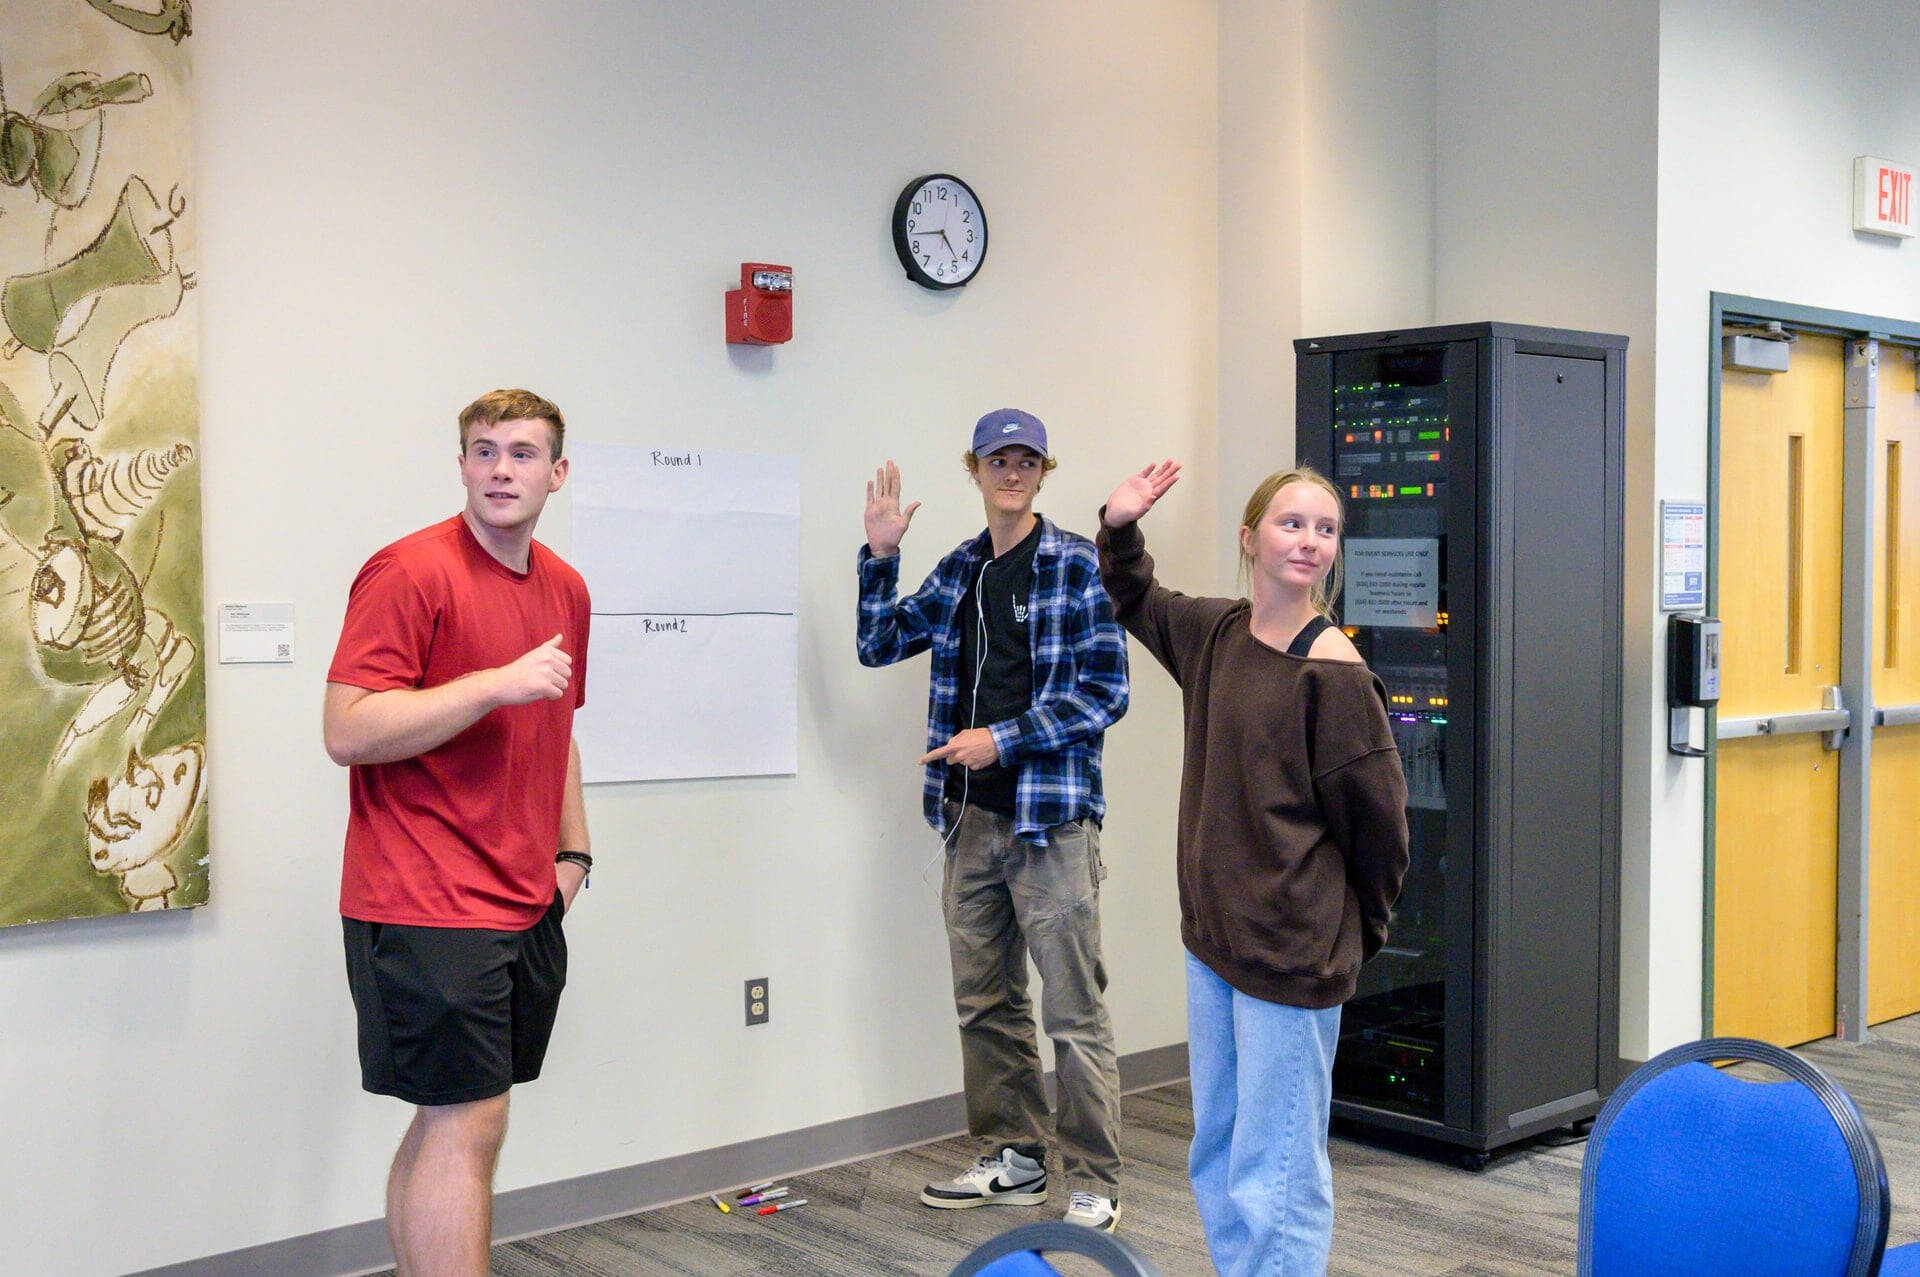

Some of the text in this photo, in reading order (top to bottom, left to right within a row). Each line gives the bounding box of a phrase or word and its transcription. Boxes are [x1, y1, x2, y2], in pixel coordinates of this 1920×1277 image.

[923, 189, 932, 204] 11
[936, 186, 947, 200] 12
[1878, 168, 1911, 225] EXIT
[912, 201, 922, 215] 10
[963, 210, 970, 224] 2
[908, 219, 915, 233] 9
[966, 229, 974, 243] 3
[912, 240, 920, 254] 8
[923, 255, 931, 268] 7
[961, 249, 968, 262] 4
[936, 263, 944, 277] 6
[951, 260, 958, 273] 5
[650, 451, 691, 466] Round
[643, 617, 688, 633] Round 2
